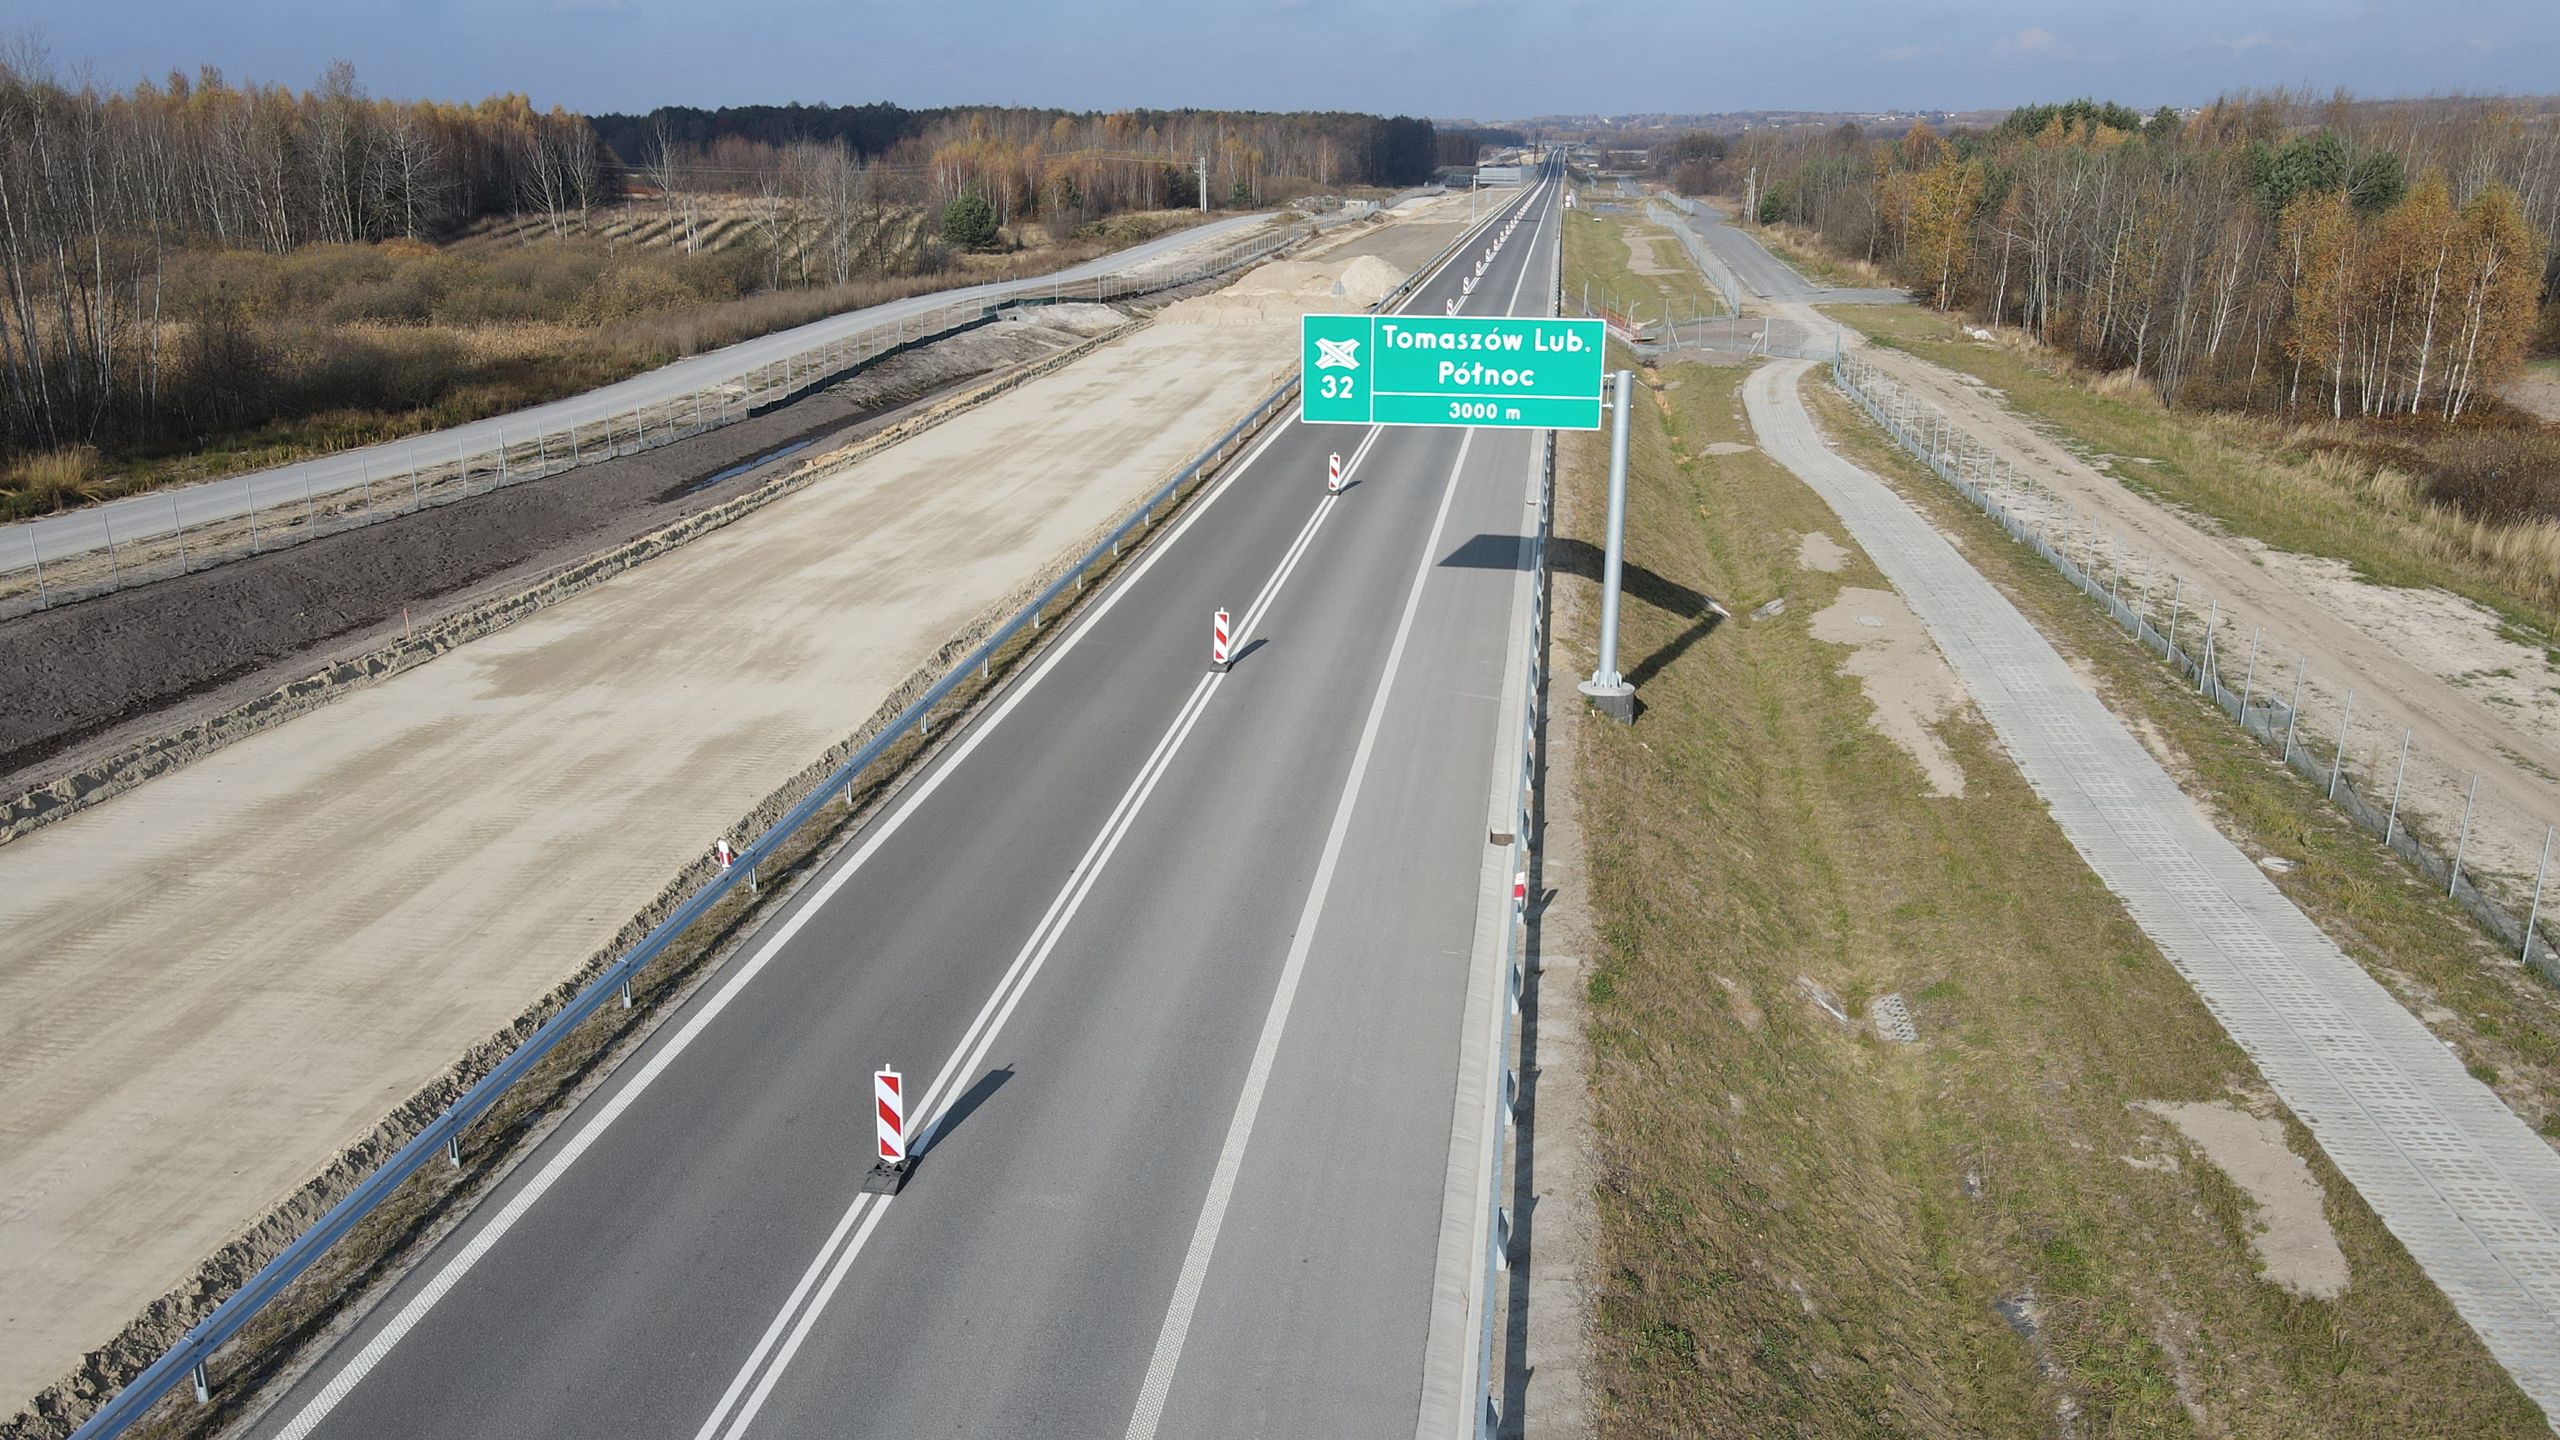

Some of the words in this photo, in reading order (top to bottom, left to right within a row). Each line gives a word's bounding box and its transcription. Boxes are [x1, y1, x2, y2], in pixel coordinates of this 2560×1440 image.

[1381, 325, 1524, 351] Tomaszów
[1534, 328, 1591, 353] Lub.
[1438, 361, 1535, 387] Północ
[1320, 375, 1354, 399] 32
[1448, 402, 1498, 420] 3000
[1505, 408, 1521, 420] m
